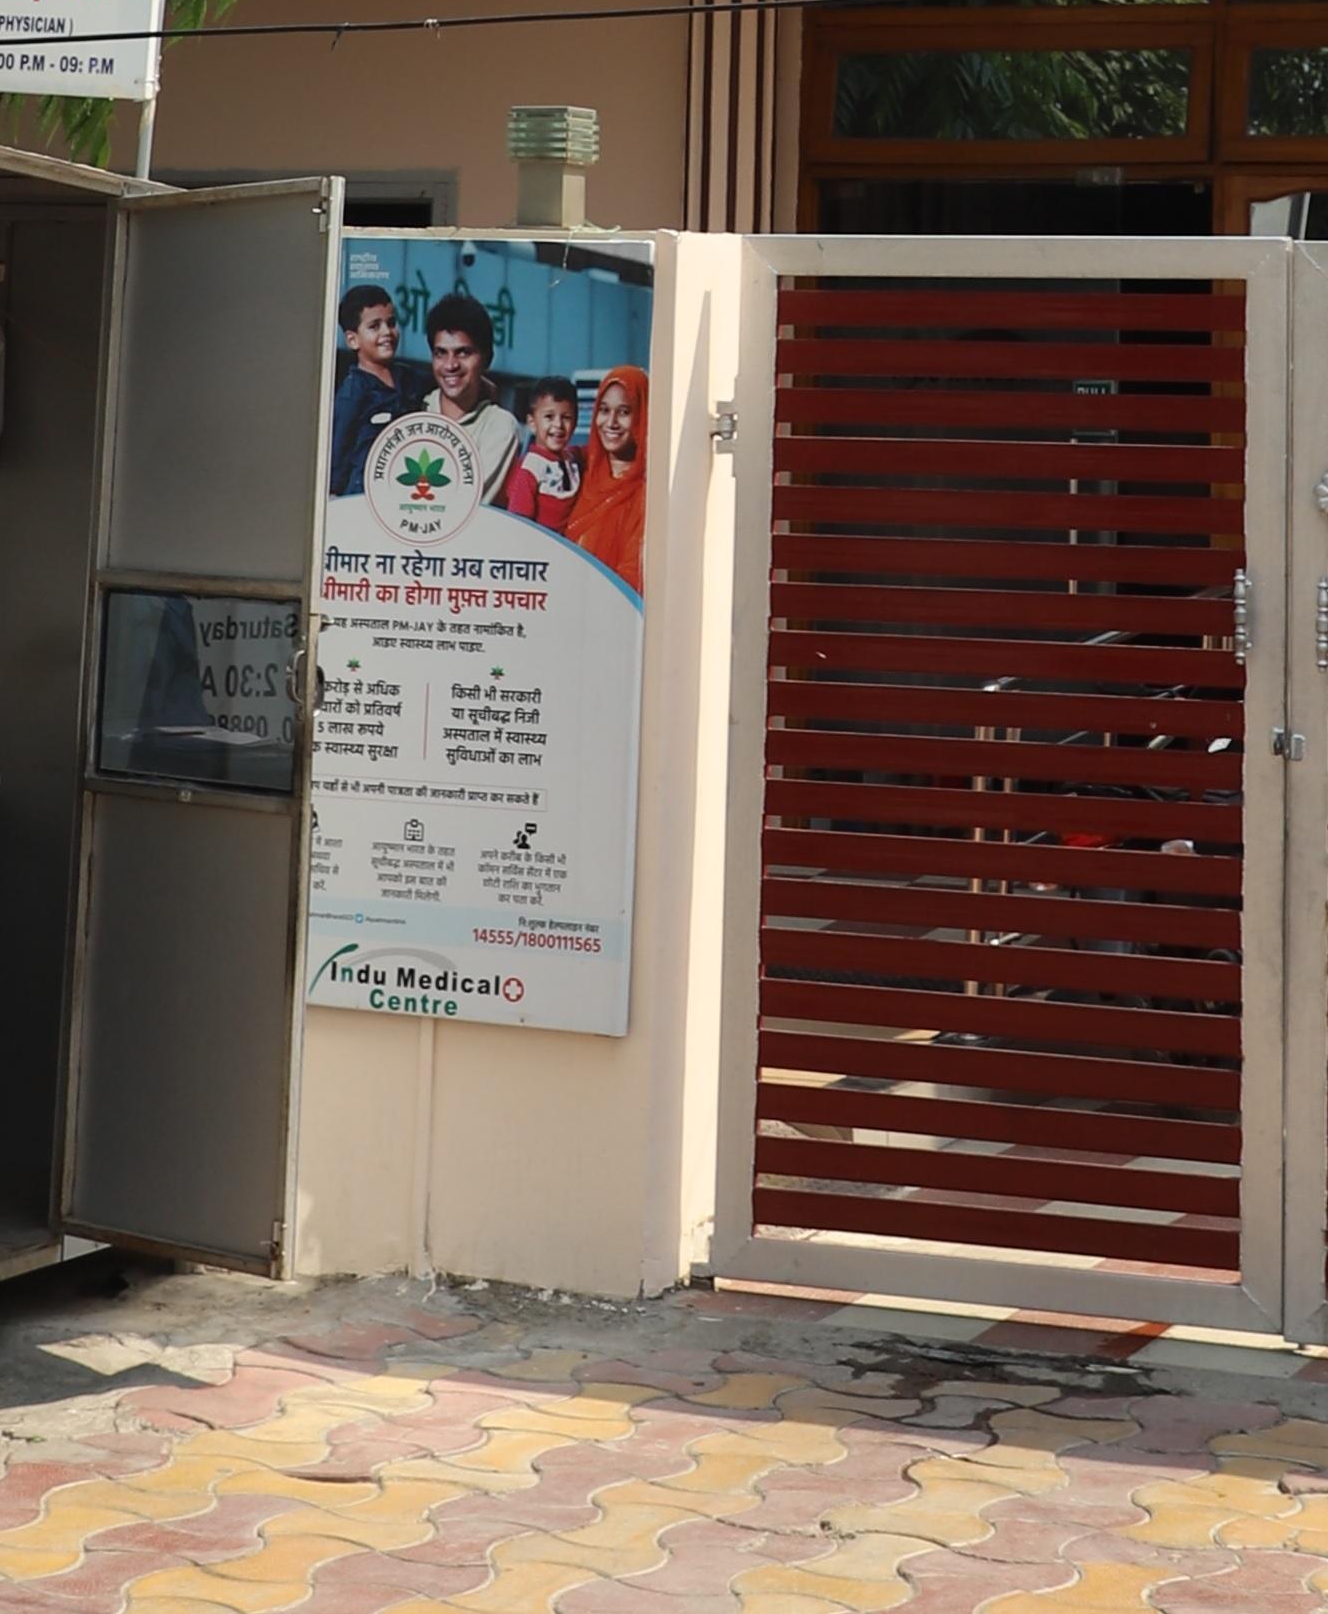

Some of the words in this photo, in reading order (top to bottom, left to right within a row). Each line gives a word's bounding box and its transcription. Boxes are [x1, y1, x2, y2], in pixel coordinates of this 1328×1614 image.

[20, 54, 44, 71] P.M
[88, 58, 114, 74] P.M
[376, 554, 395, 574] ना
[401, 550, 446, 578] रहेगा
[451, 557, 484, 579] अब
[489, 558, 549, 582] लाचार
[375, 583, 400, 604] का
[405, 580, 442, 606] होगा
[493, 589, 548, 611] उपचार
[393, 621, 434, 633] PM-JAY
[354, 680, 363, 694] से
[367, 680, 401, 697] अधिक
[451, 683, 480, 700] किसी
[484, 686, 496, 701] भी
[500, 687, 542, 704] सरकारी
[499, 752, 515, 765] का
[472, 928, 601, 952] 14555/1800111565
[331, 961, 386, 985] Indu
[397, 966, 500, 996] Medical
[369, 988, 458, 1016] Centre
